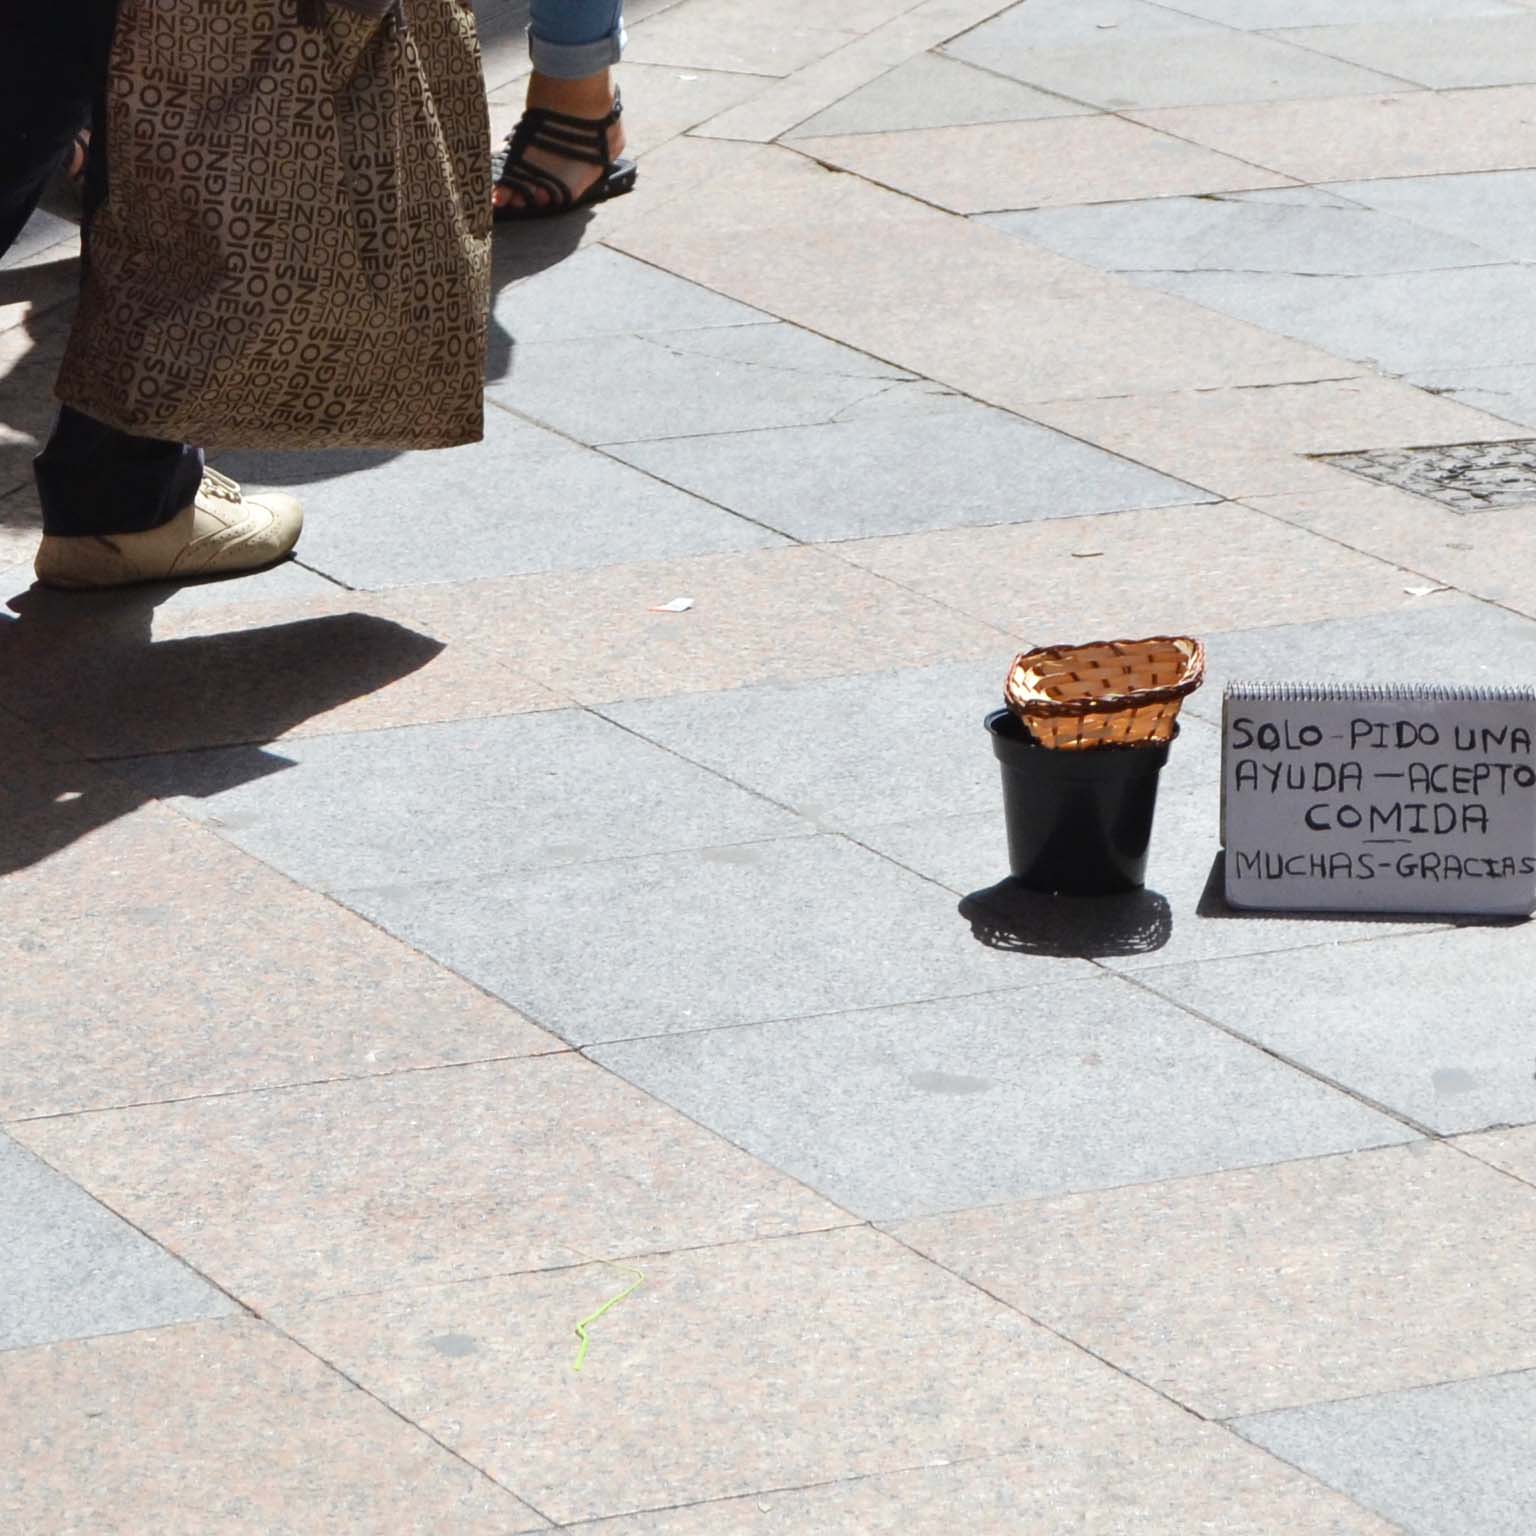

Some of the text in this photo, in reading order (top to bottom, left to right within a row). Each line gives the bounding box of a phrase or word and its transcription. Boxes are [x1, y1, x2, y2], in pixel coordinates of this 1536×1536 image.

[154, 67, 189, 184] SOIGNE
[216, 195, 253, 315] SOIGNE
[243, 198, 279, 318] SOIGNE
[248, 263, 296, 373] SOIGNE
[268, 264, 319, 374] SOIGNE
[269, 324, 329, 423] SOIGNE
[292, 324, 350, 425] SOIGNE
[1232, 718, 1323, 751] SOLO
[1350, 718, 1439, 749] PIDO
[1454, 726, 1531, 754] UNA
[1234, 759, 1363, 794] AYUDA
[1407, 762, 1536, 796] ACEPTO
[1304, 802, 1489, 835] COMIDA
